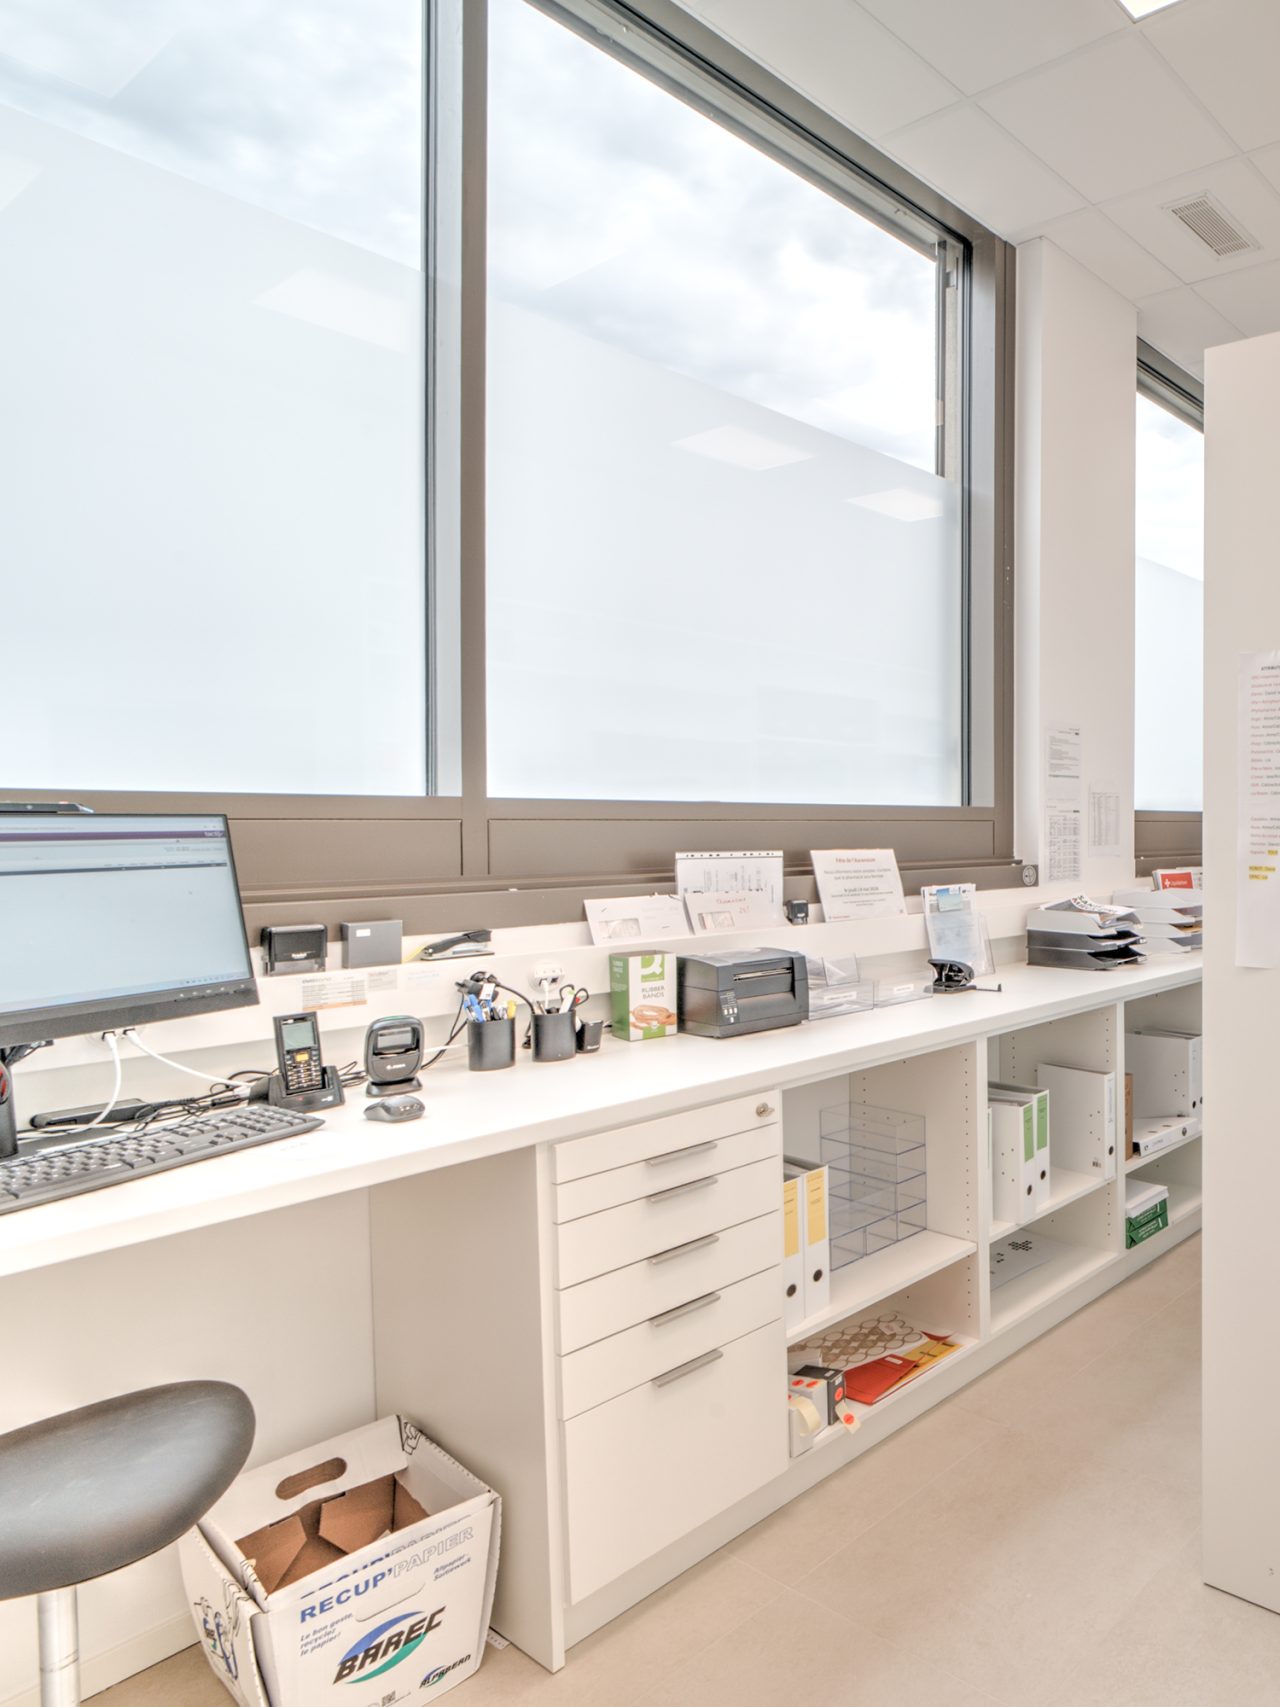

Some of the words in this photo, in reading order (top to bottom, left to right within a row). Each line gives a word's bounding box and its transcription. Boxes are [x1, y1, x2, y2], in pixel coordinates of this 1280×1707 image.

[642, 985, 665, 993] RUBBER
[642, 992, 665, 1000] BANDS
[300, 1633, 311, 1642] Le
[312, 1625, 328, 1636] bon
[300, 1628, 336, 1649] recyclez
[333, 1606, 446, 1685] BAREC
